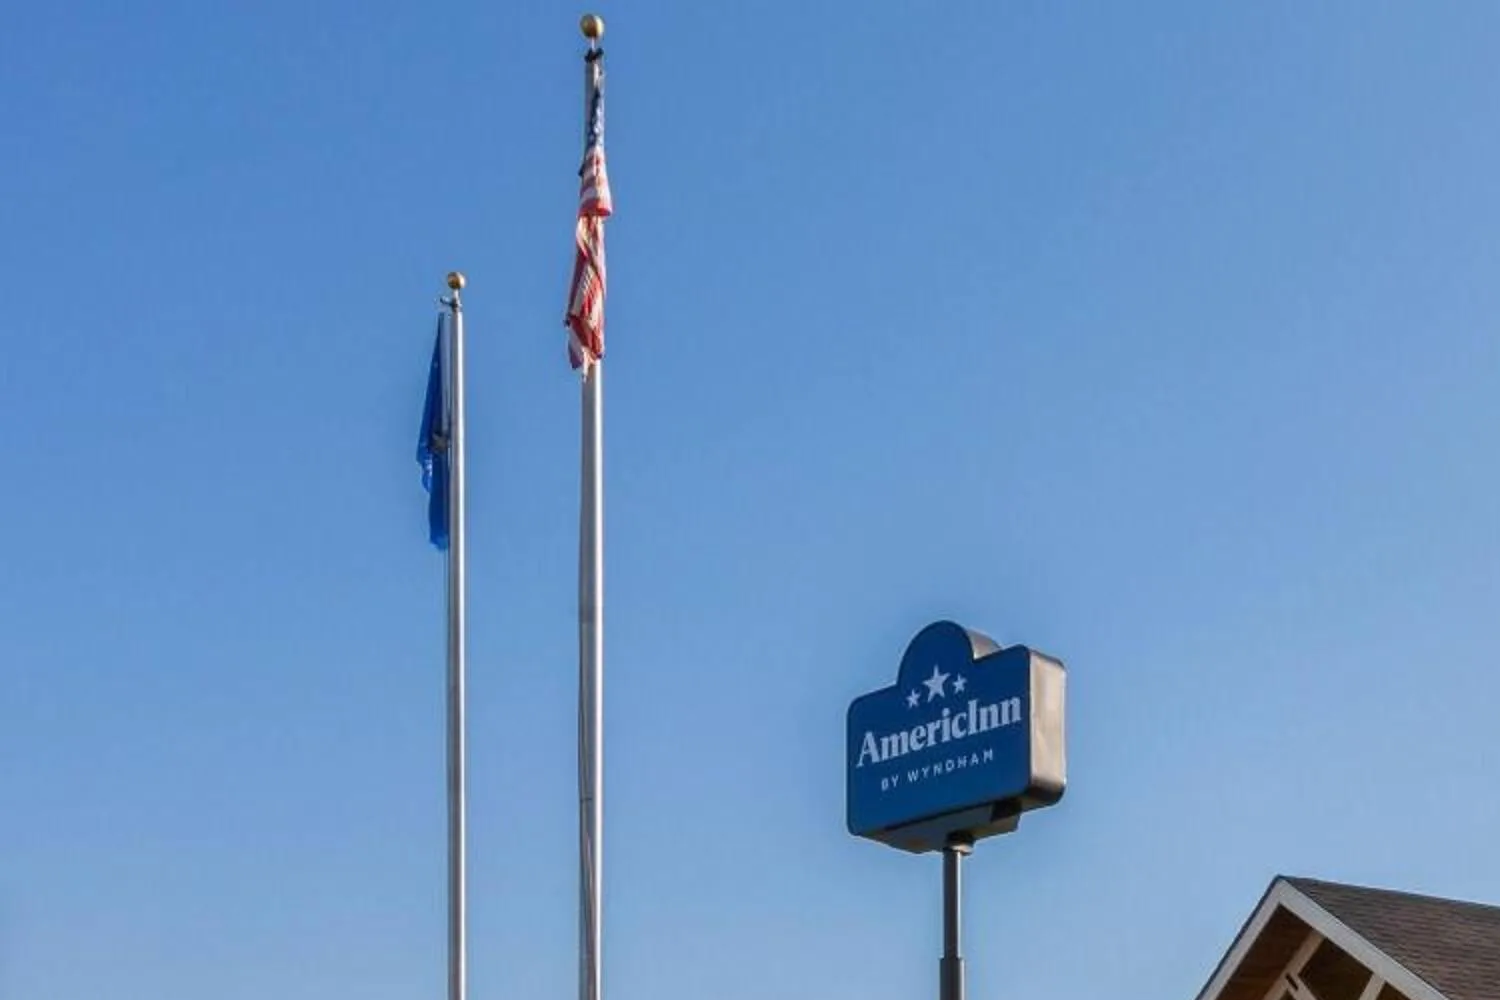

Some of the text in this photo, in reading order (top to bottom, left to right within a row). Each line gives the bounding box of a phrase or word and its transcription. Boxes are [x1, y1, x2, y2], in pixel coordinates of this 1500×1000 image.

[857, 697, 1022, 767] AmericInn
[881, 749, 993, 791] BY WYNDHAM
